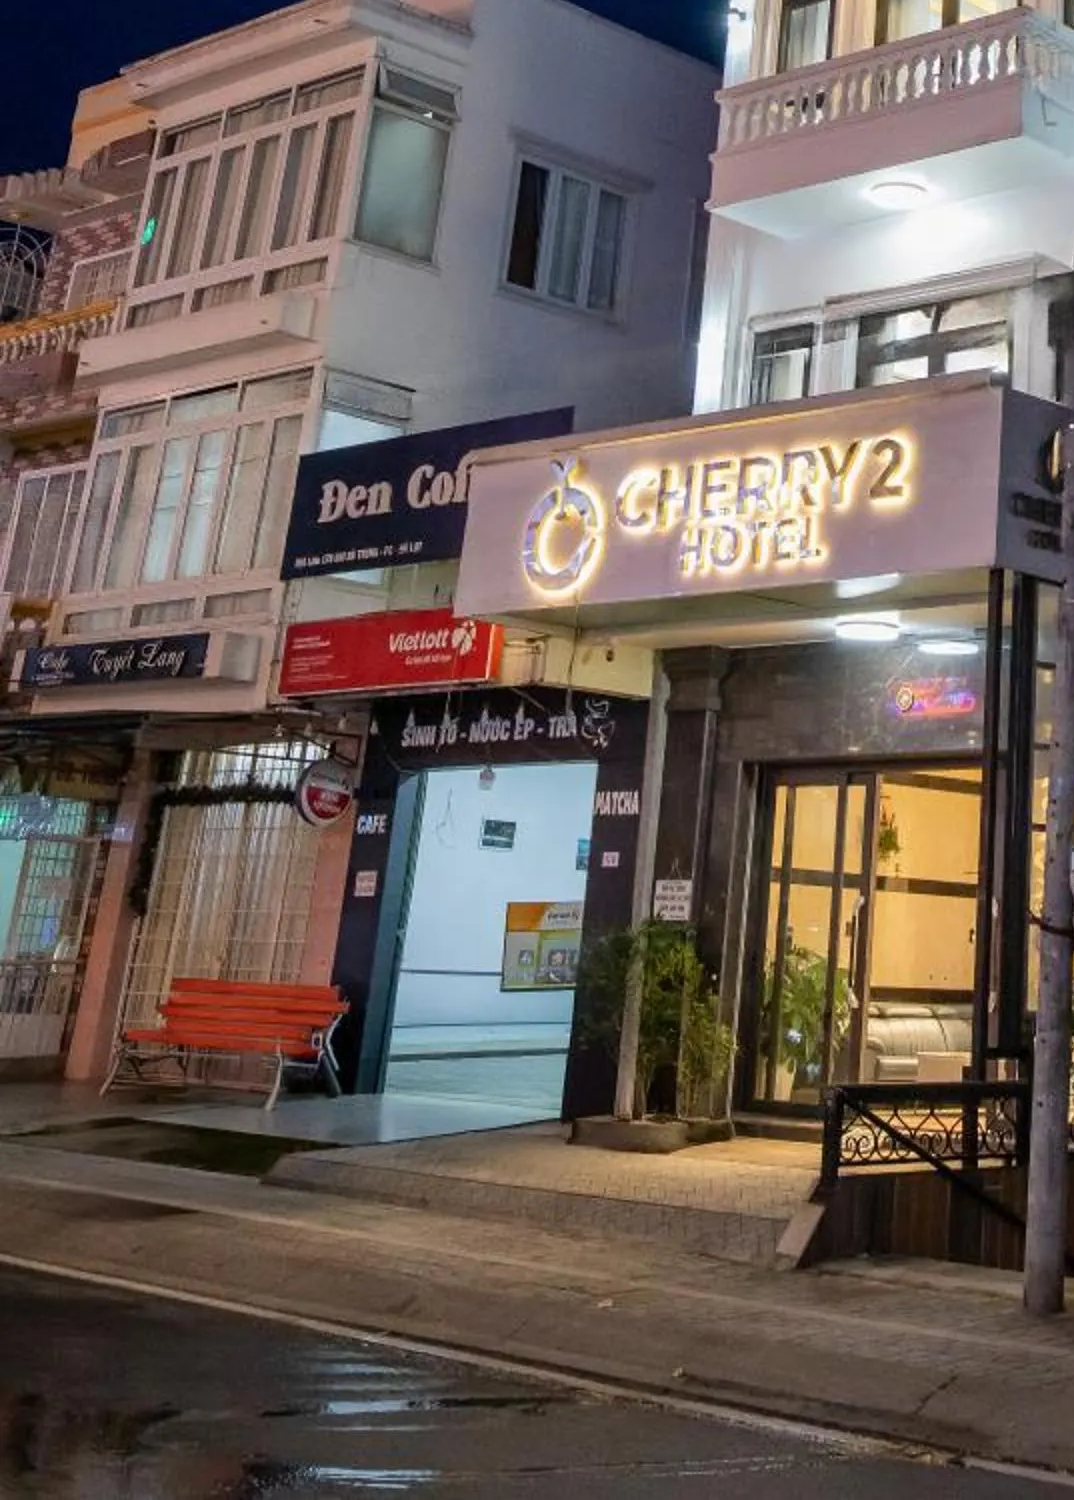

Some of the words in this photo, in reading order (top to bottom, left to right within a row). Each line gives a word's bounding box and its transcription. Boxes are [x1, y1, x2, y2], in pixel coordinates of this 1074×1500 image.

[407, 452, 472, 509] Cof
[615, 440, 861, 527] CHERRY
[680, 516, 821, 571] HOTEL
[389, 628, 450, 653] Vietlott
[594, 790, 639, 816] MATCHA
